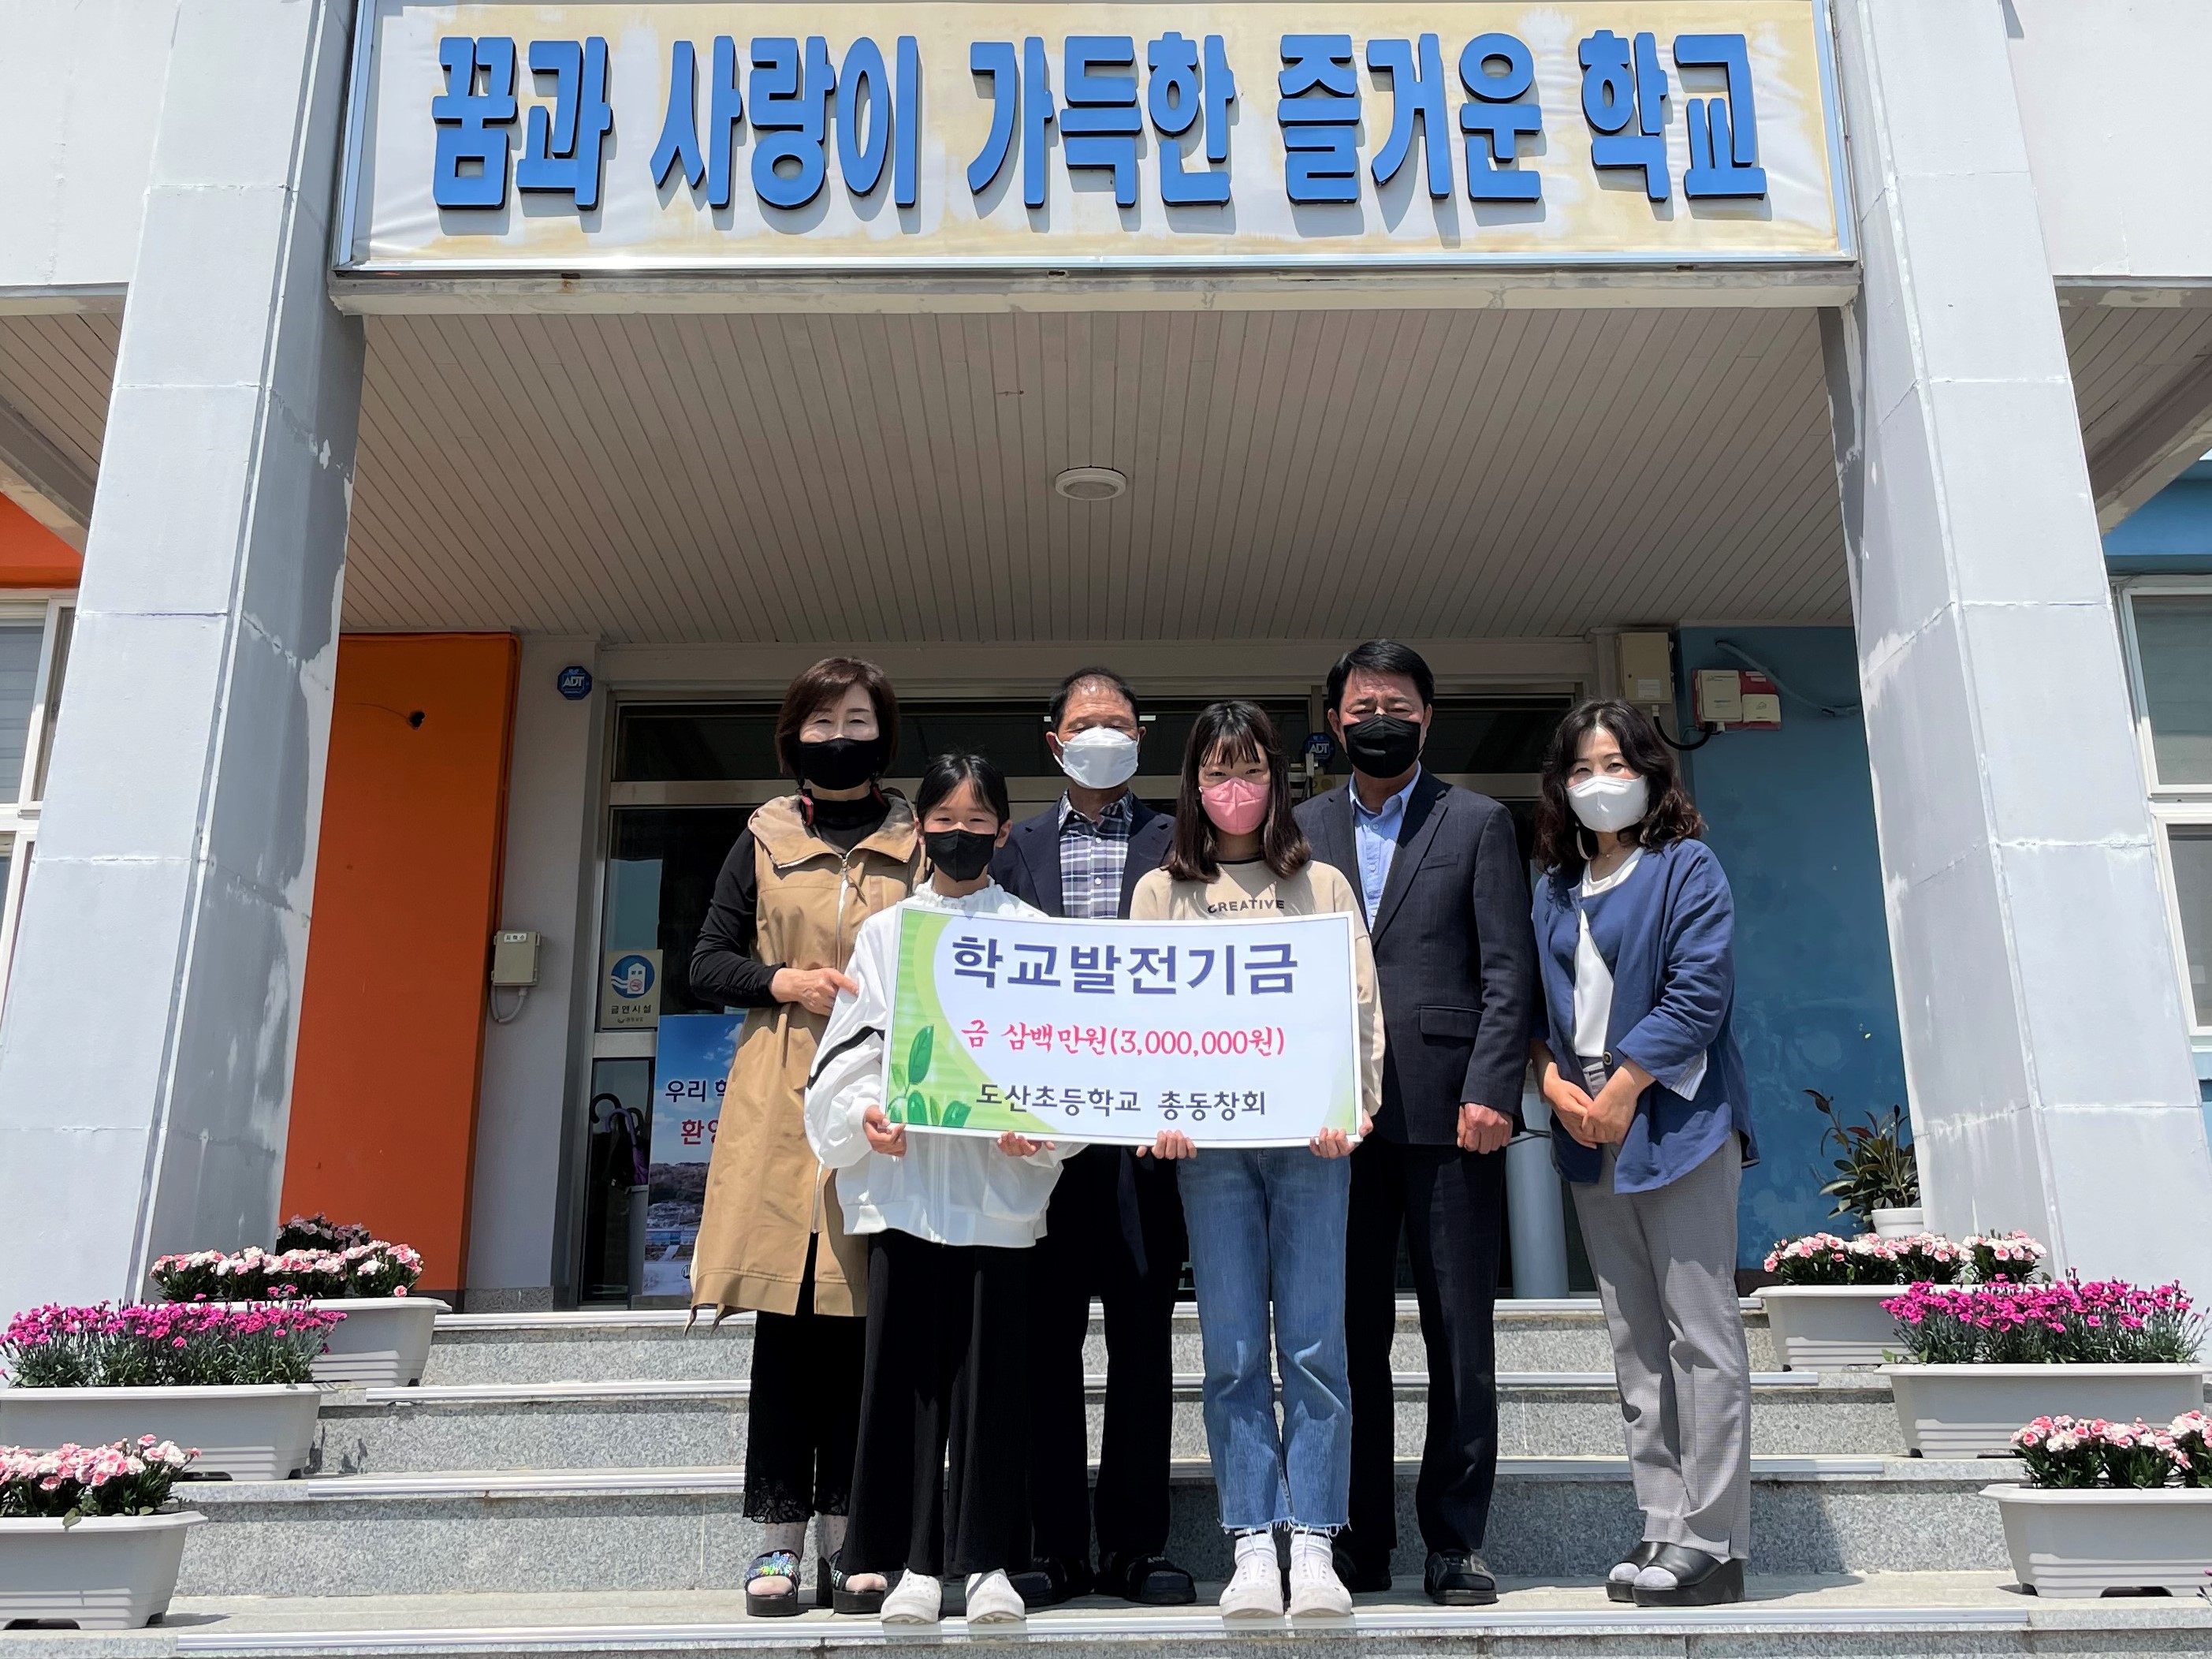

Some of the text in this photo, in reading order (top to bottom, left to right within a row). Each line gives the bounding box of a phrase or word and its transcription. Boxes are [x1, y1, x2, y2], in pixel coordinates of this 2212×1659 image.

[432, 30, 1768, 211] 꿈과 사랑이 가득한 즐거운 학교
[562, 676, 585, 688] ADT
[1309, 743, 1329, 754] ADT
[1207, 899, 1285, 914] CREATIVE
[951, 935, 1299, 996] 학교발전기금
[610, 1004, 652, 1015] 금연시설
[961, 1019, 989, 1048] 금
[665, 1079, 706, 1103] 우리
[976, 1083, 1266, 1121] 도산초등학교 총동창회
